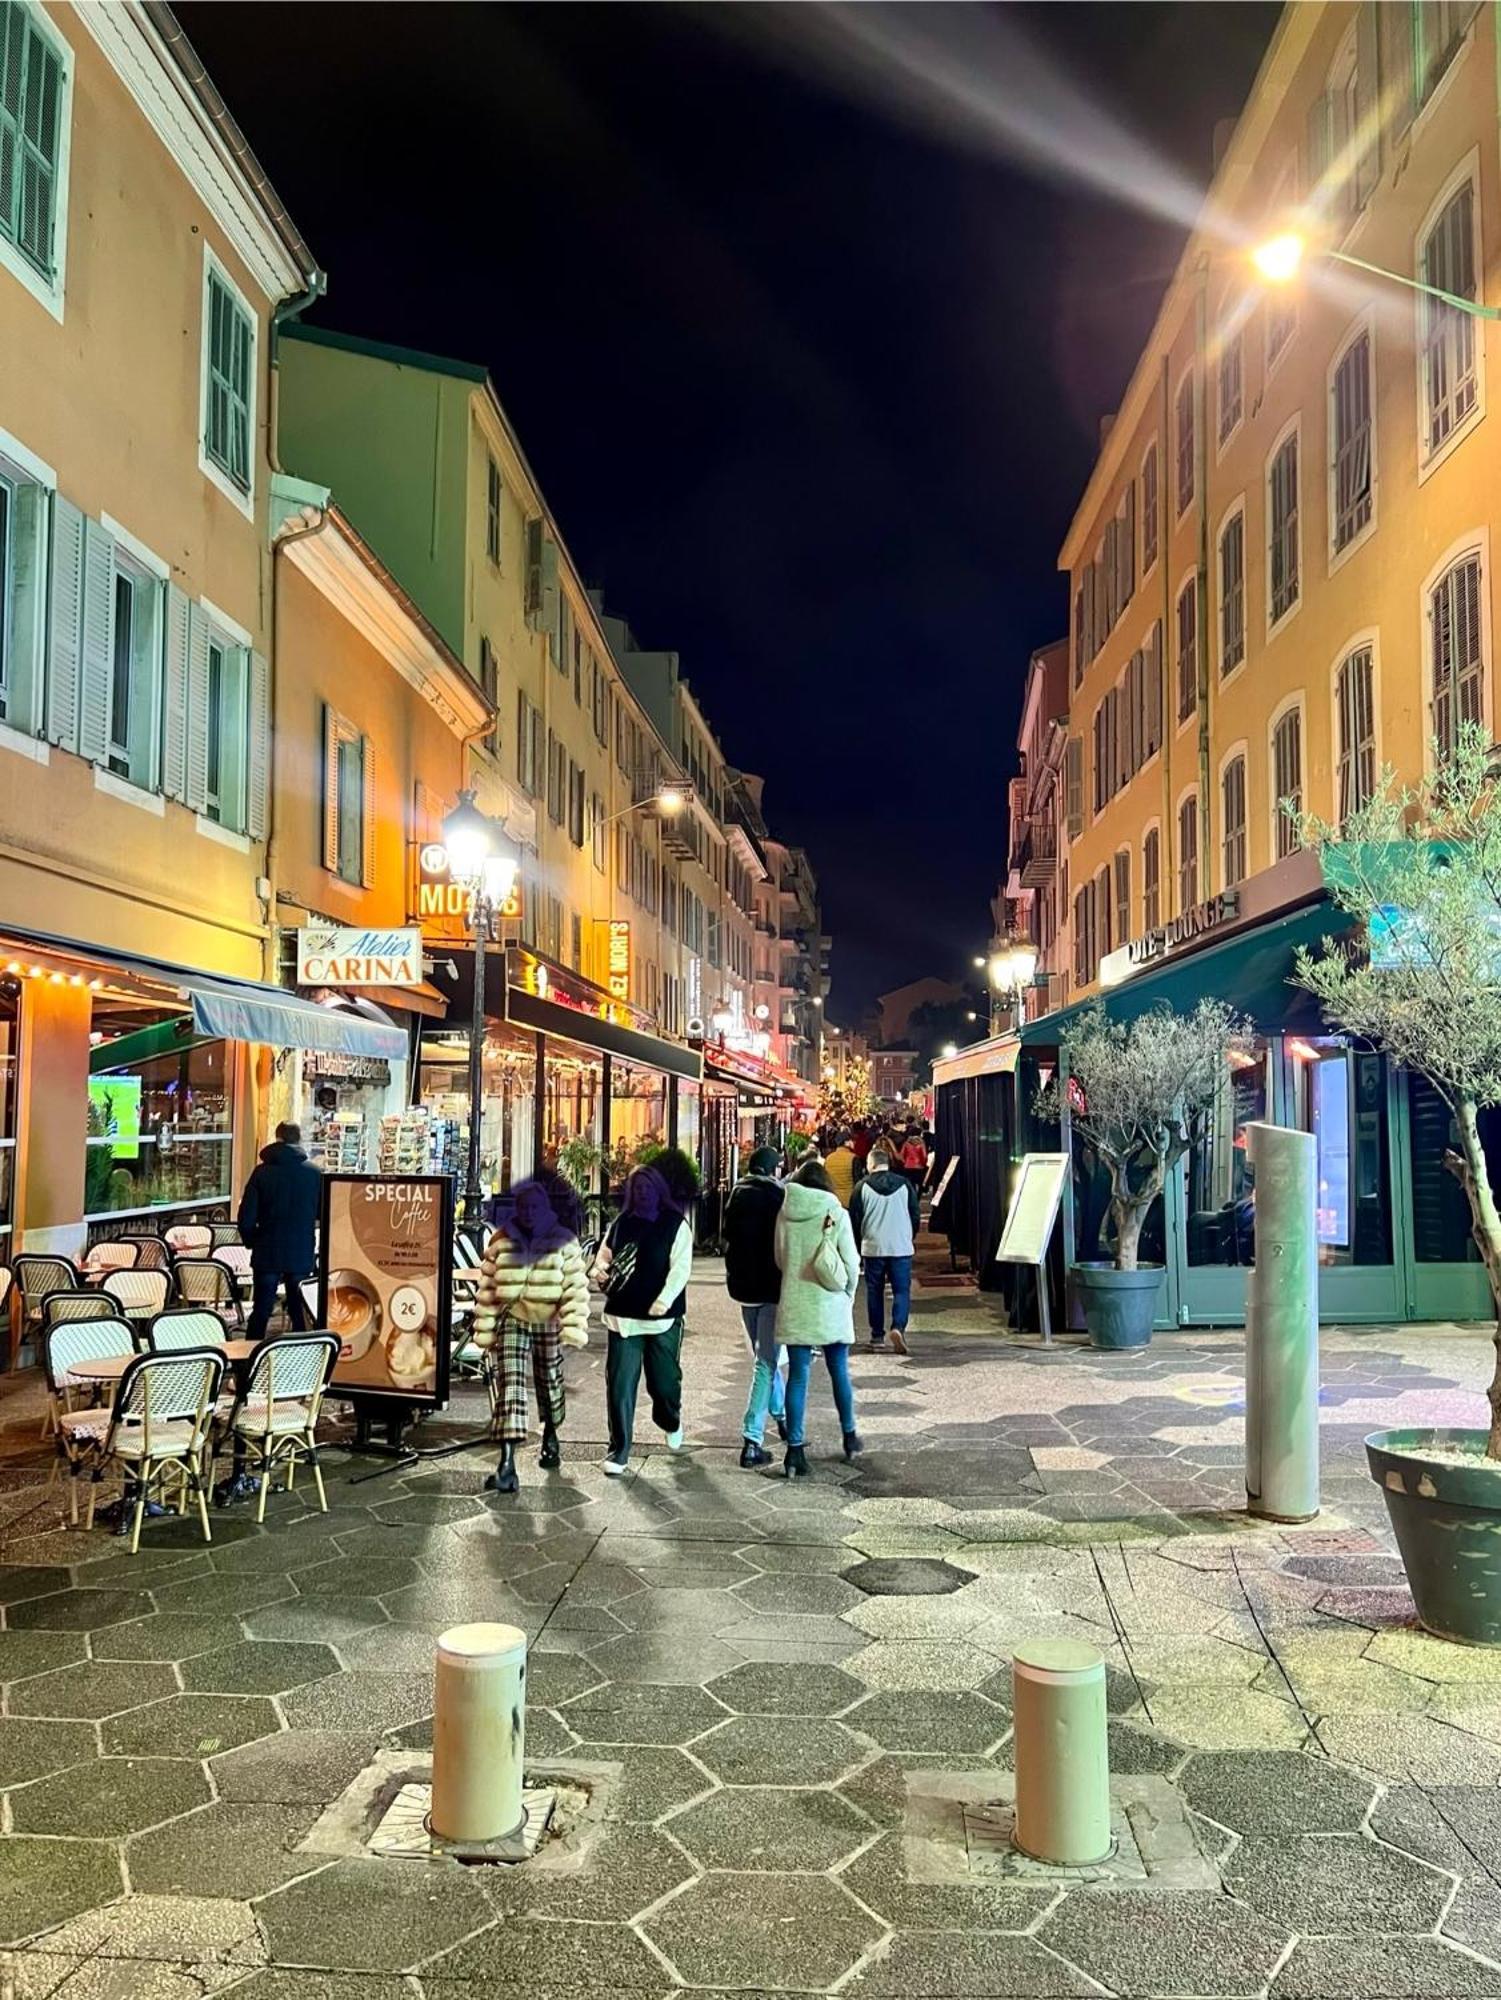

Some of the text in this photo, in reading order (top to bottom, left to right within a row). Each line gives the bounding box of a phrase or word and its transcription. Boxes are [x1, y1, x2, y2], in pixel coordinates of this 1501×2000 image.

[339, 932, 412, 956] Atelier
[304, 958, 412, 981] CARINA
[365, 1184, 433, 1202] SPECIAL
[390, 1199, 431, 1235] Coffee
[401, 1302, 416, 1316] 2€
